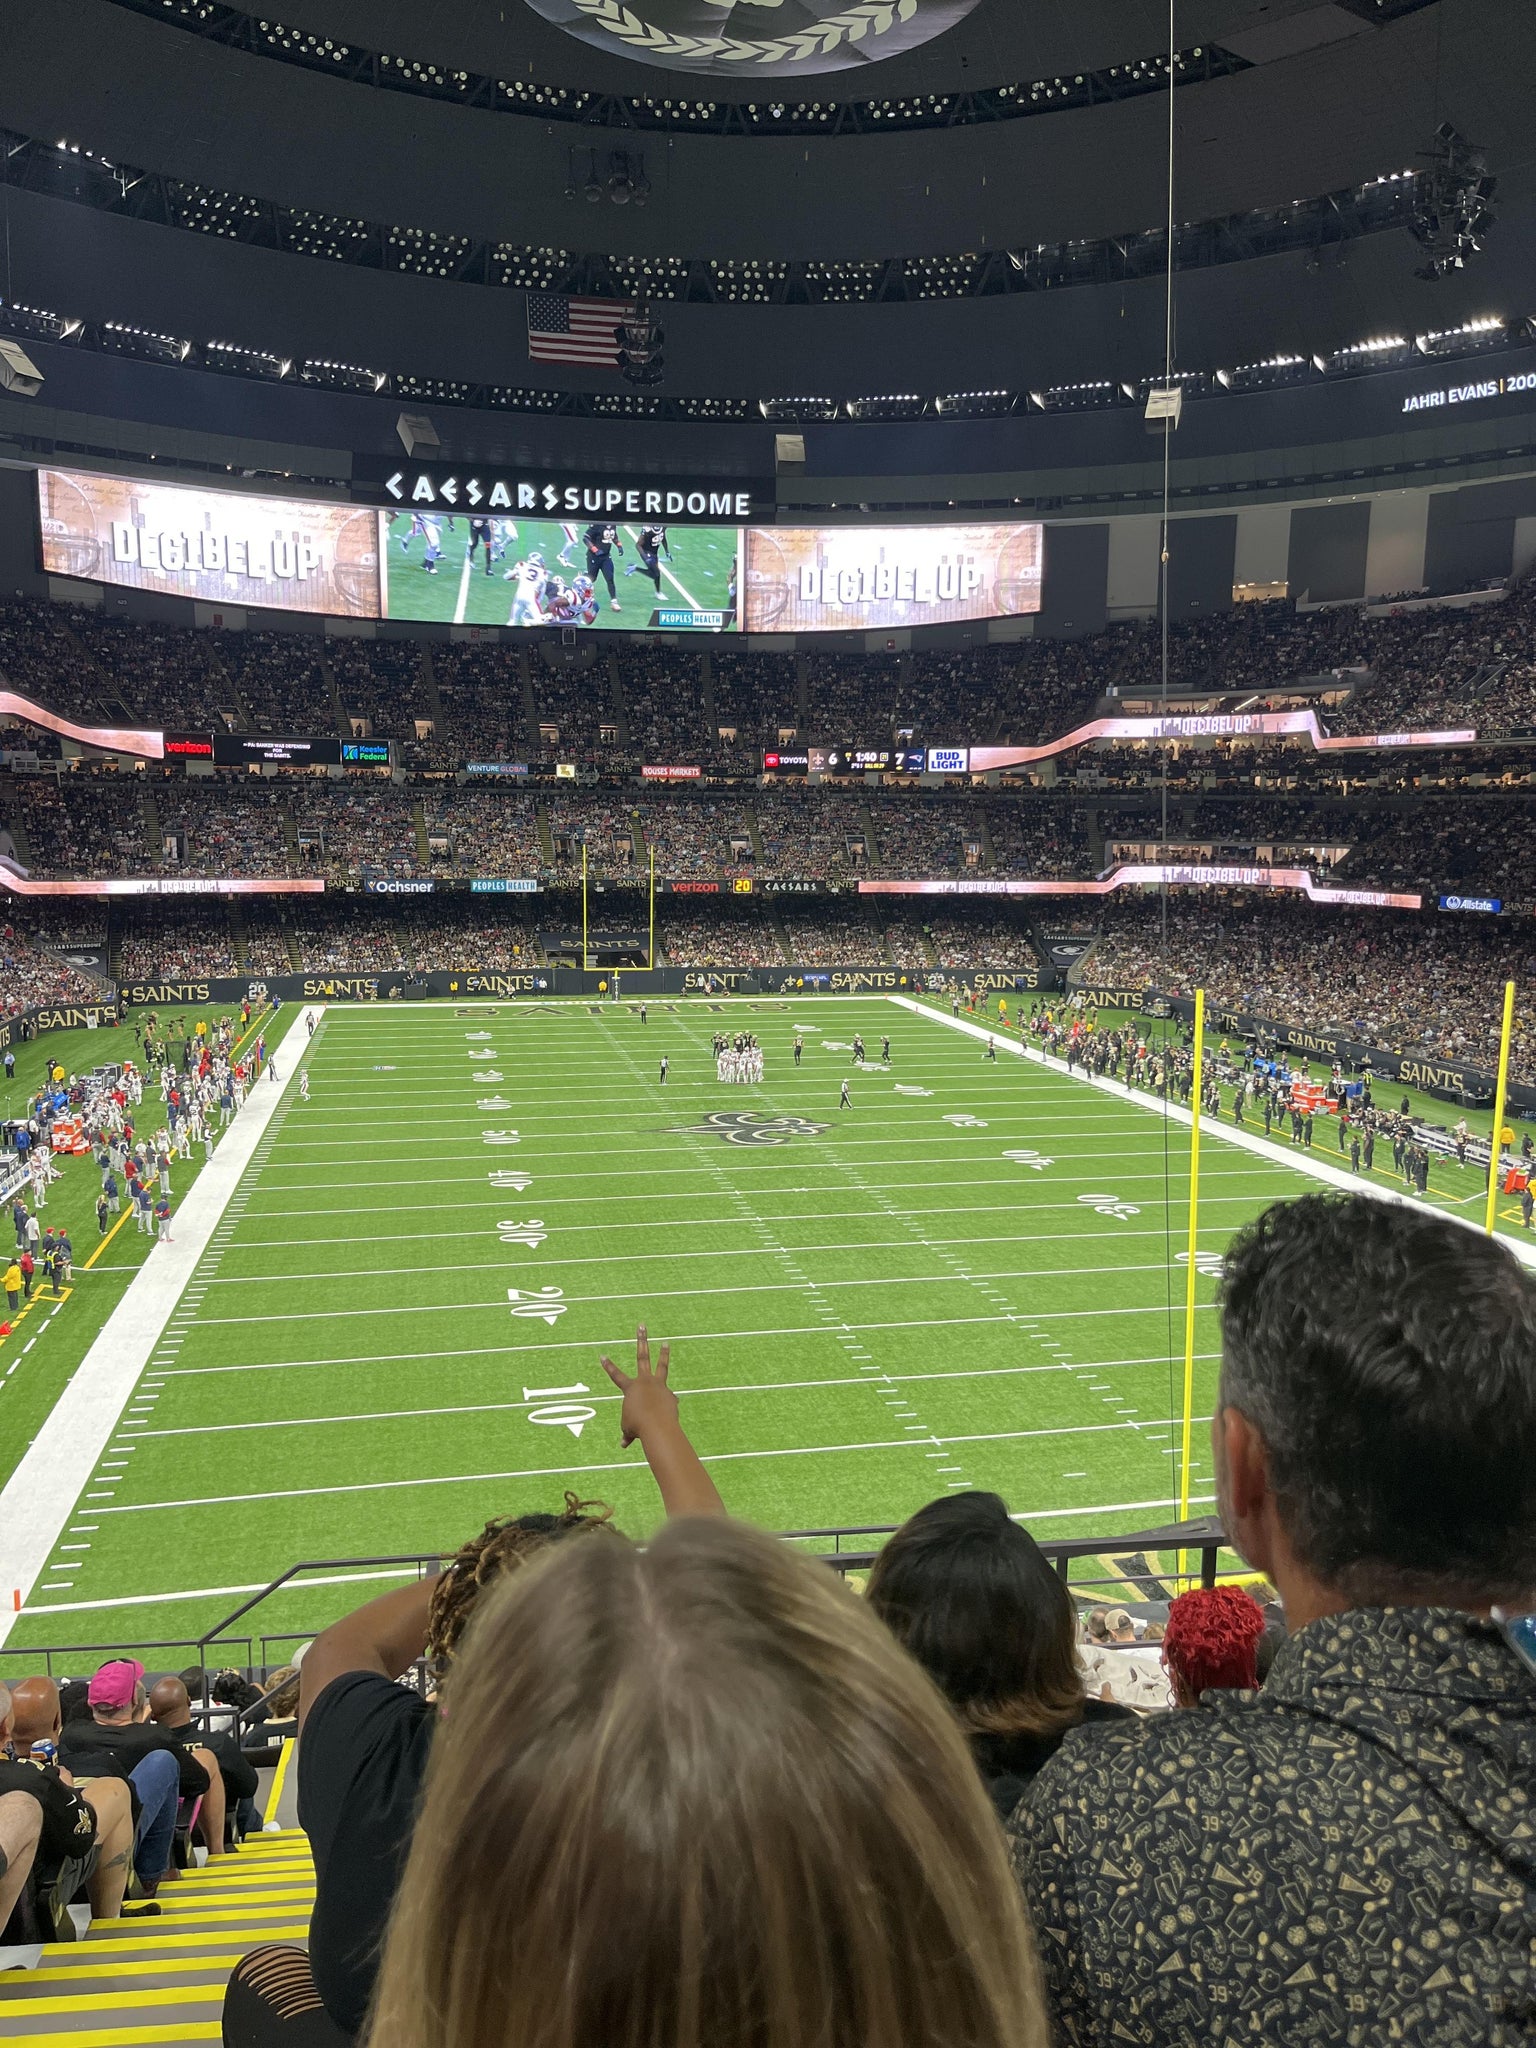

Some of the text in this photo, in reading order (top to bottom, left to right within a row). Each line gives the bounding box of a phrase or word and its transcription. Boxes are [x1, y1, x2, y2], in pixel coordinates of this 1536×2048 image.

[1401, 391, 1445, 413] JAHRI
[1448, 381, 1498, 404] EVANS
[385, 472, 750, 515] CAESARS SUPERDOME
[110, 520, 320, 581] DECIBEL UP
[799, 564, 981, 605] DECIBEL UP
[661, 612, 722, 624] PEOPLES HEALTH
[1182, 715, 1251, 734] DECIBEL UP
[1480, 731, 1511, 739] SAINTS
[165, 741, 212, 754] verizon
[359, 745, 388, 753] Keesler
[359, 752, 388, 761] Federal
[779, 756, 807, 765] TOYOTA
[828, 752, 838, 765] 6
[855, 752, 878, 762] 1:40
[894, 753, 905, 765] 7
[935, 752, 960, 760] BUD
[429, 762, 459, 770] SAINTS
[467, 764, 528, 774] VENTURE GLOBAL
[604, 765, 632, 773] SAINTS
[642, 766, 700, 777] ROUSES MARKETS
[931, 760, 965, 769] LIGHT
[327, 879, 361, 887] SAINTS
[1191, 867, 1260, 883] DECIBEL UP
[376, 880, 433, 893] Ochsner
[472, 881, 536, 892] PEOPLES HEALTH
[671, 881, 719, 893] verizon
[734, 880, 751, 892] 20
[764, 882, 817, 891] CAESARS
[1346, 891, 1385, 905] DECIBEL UP
[1459, 901, 1493, 911] Allstate
[1503, 901, 1533, 911] SAINTS
[559, 939, 640, 948] SAINTS
[466, 974, 535, 992] SAINTS
[684, 972, 749, 989] SAINT
[831, 971, 896, 988] SAINTS
[132, 983, 210, 1004] SAINTS
[1076, 990, 1143, 1008] SAINTS
[38, 1005, 117, 1030] SAINTS
[1399, 1060, 1465, 1092] SAINTS
[941, 1113, 989, 1128] 50
[481, 1129, 521, 1145] 50
[1001, 1149, 1055, 1167] 40
[487, 1168, 534, 1188] 40
[1076, 1193, 1141, 1215] 30
[496, 1218, 548, 1244] 30
[507, 1285, 568, 1318] 20
[522, 1381, 597, 1427] 10
[1391, 1710, 1411, 1725] 39
[1337, 1730, 1358, 1747] 39
[1444, 1746, 1463, 1765] 39
[1092, 1814, 1108, 1830] 39
[1201, 1815, 1219, 1832] 39
[1319, 1826, 1341, 1842] 39
[1448, 1834, 1468, 1851] 39
[1125, 1856, 1143, 1879] 39
[1242, 1862, 1265, 1887] 39
[1370, 1870, 1394, 1894] 39
[1501, 1878, 1524, 1898] 39
[1095, 1971, 1112, 1989] 39
[1208, 1984, 1228, 2003] 39
[1344, 1993, 1366, 2013] 39
[1135, 2021, 1154, 2044] 39
